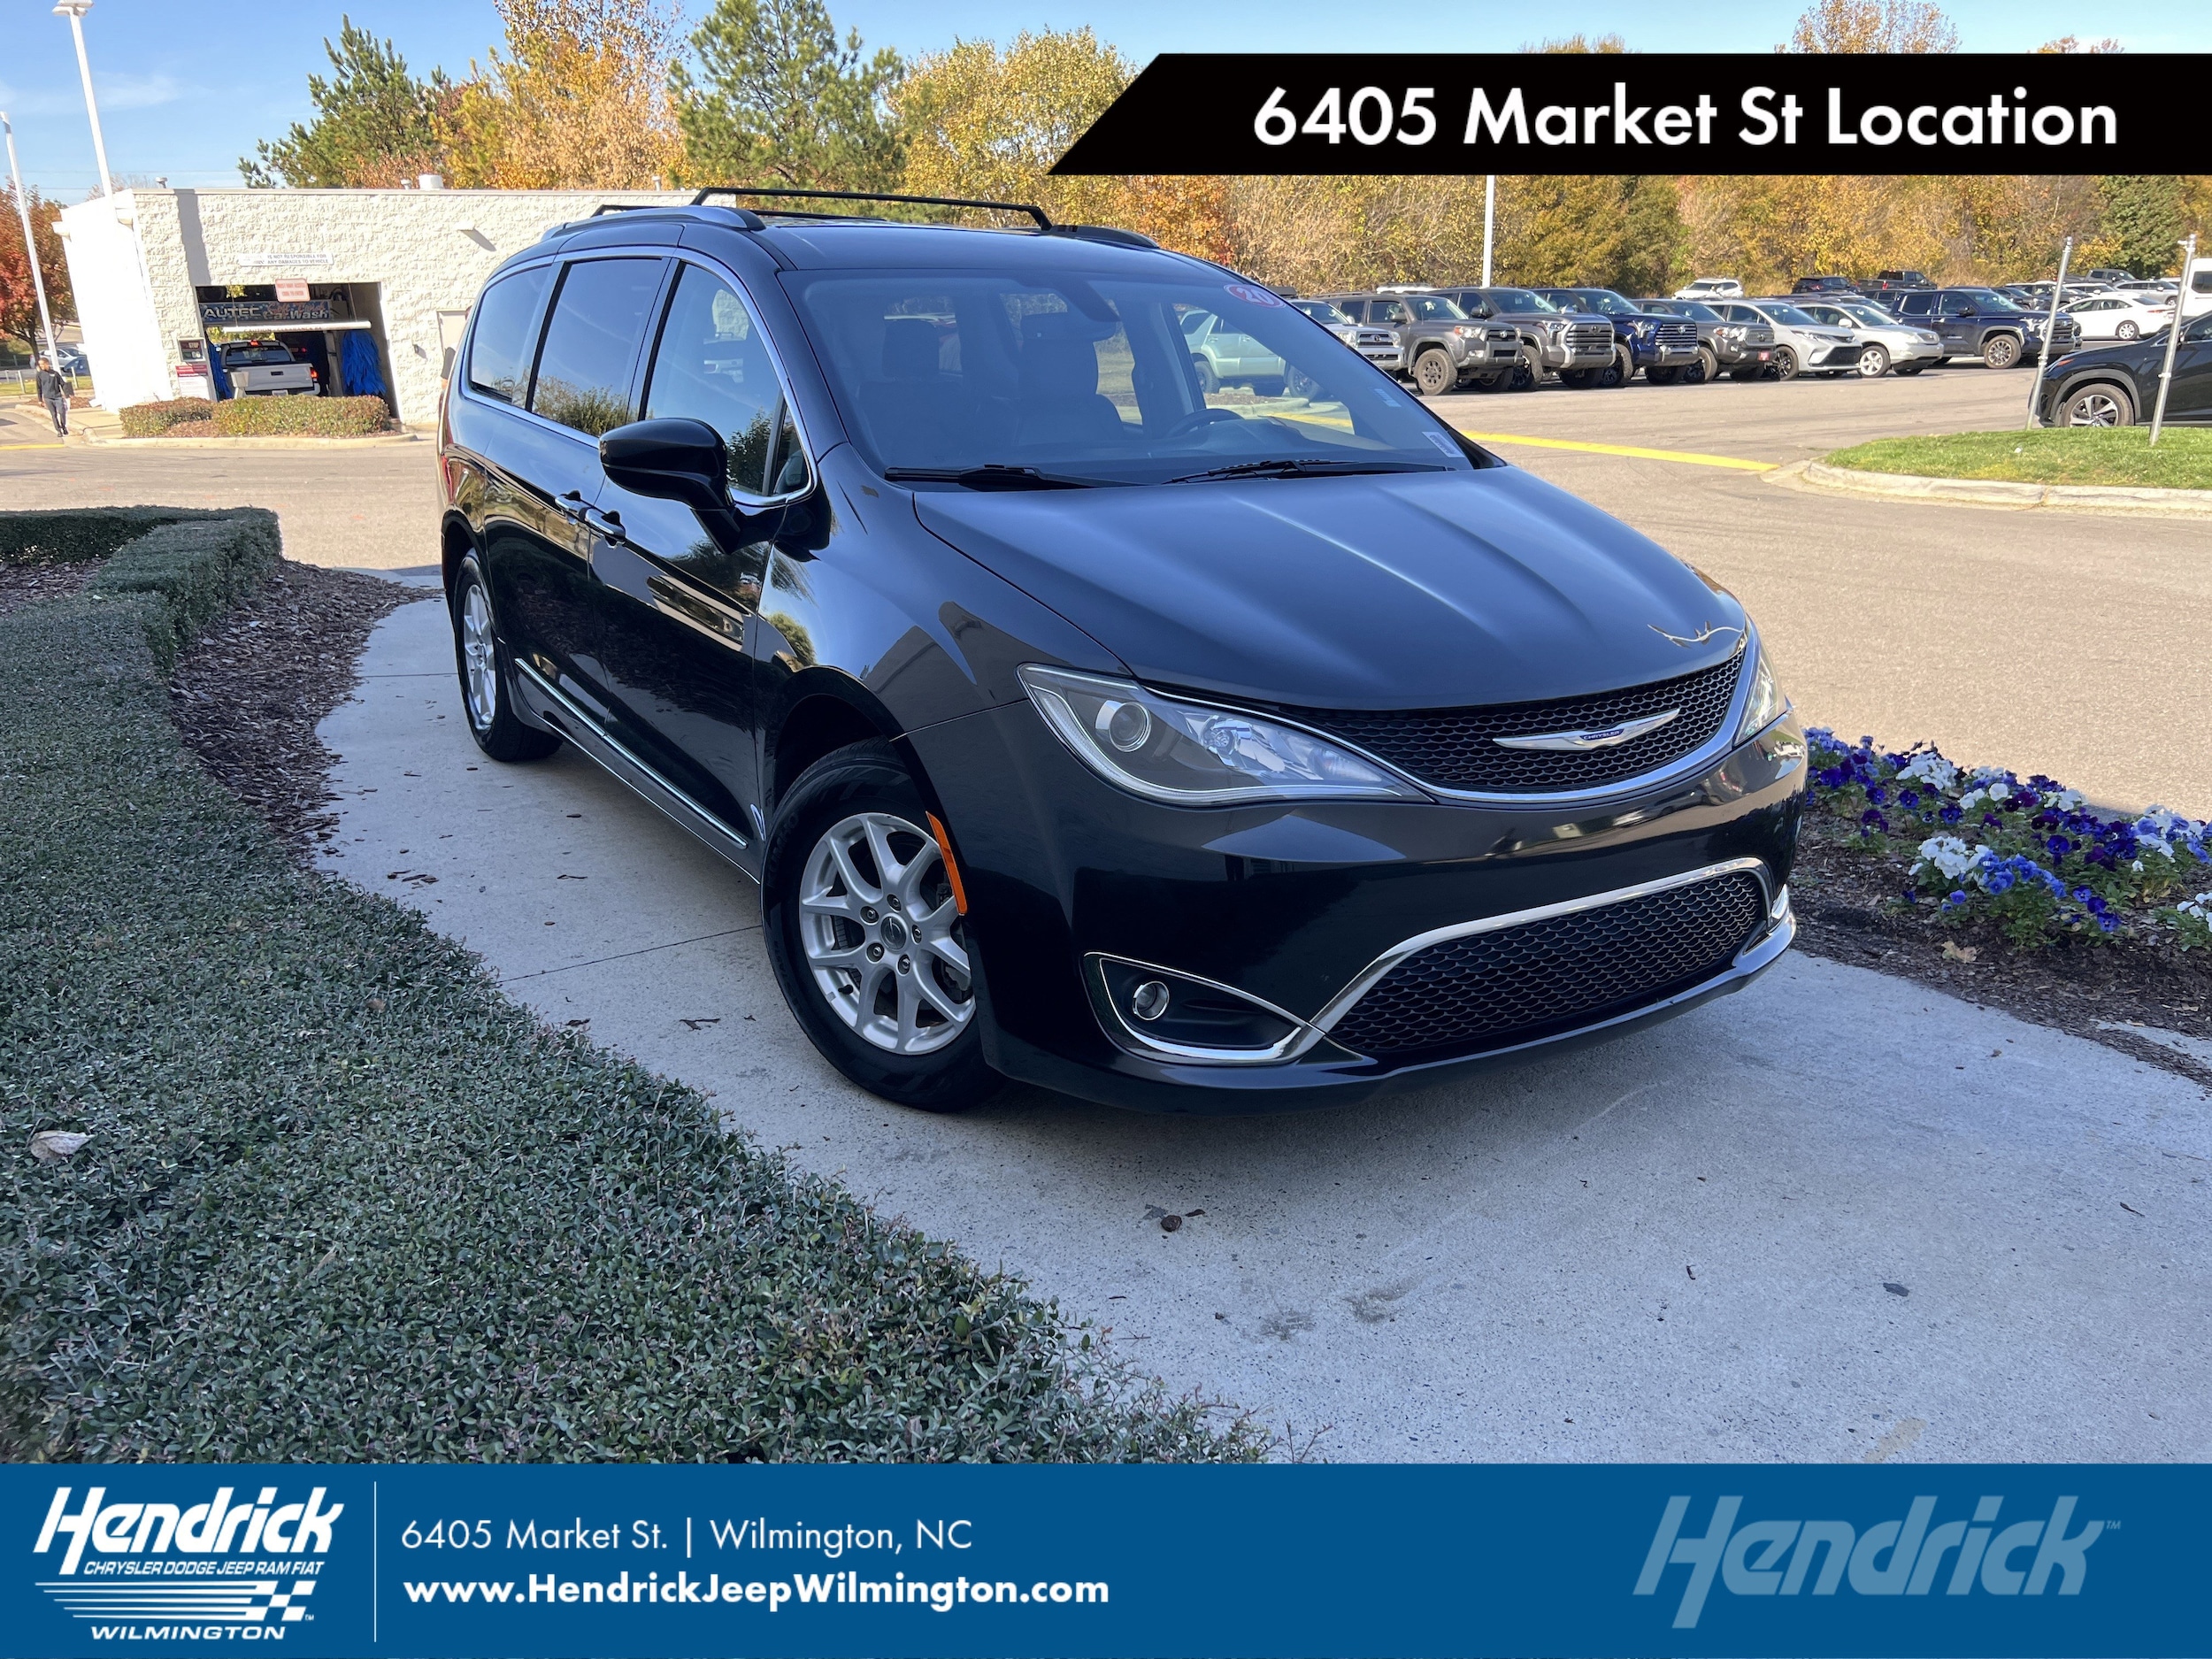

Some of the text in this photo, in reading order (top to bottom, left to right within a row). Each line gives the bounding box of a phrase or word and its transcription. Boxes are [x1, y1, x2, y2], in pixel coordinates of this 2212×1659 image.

[1237, 287, 1274, 304] 20
[204, 307, 261, 319] AUTEC
[290, 310, 327, 319] Wash
[1583, 731, 1620, 740] CHRYSLER
